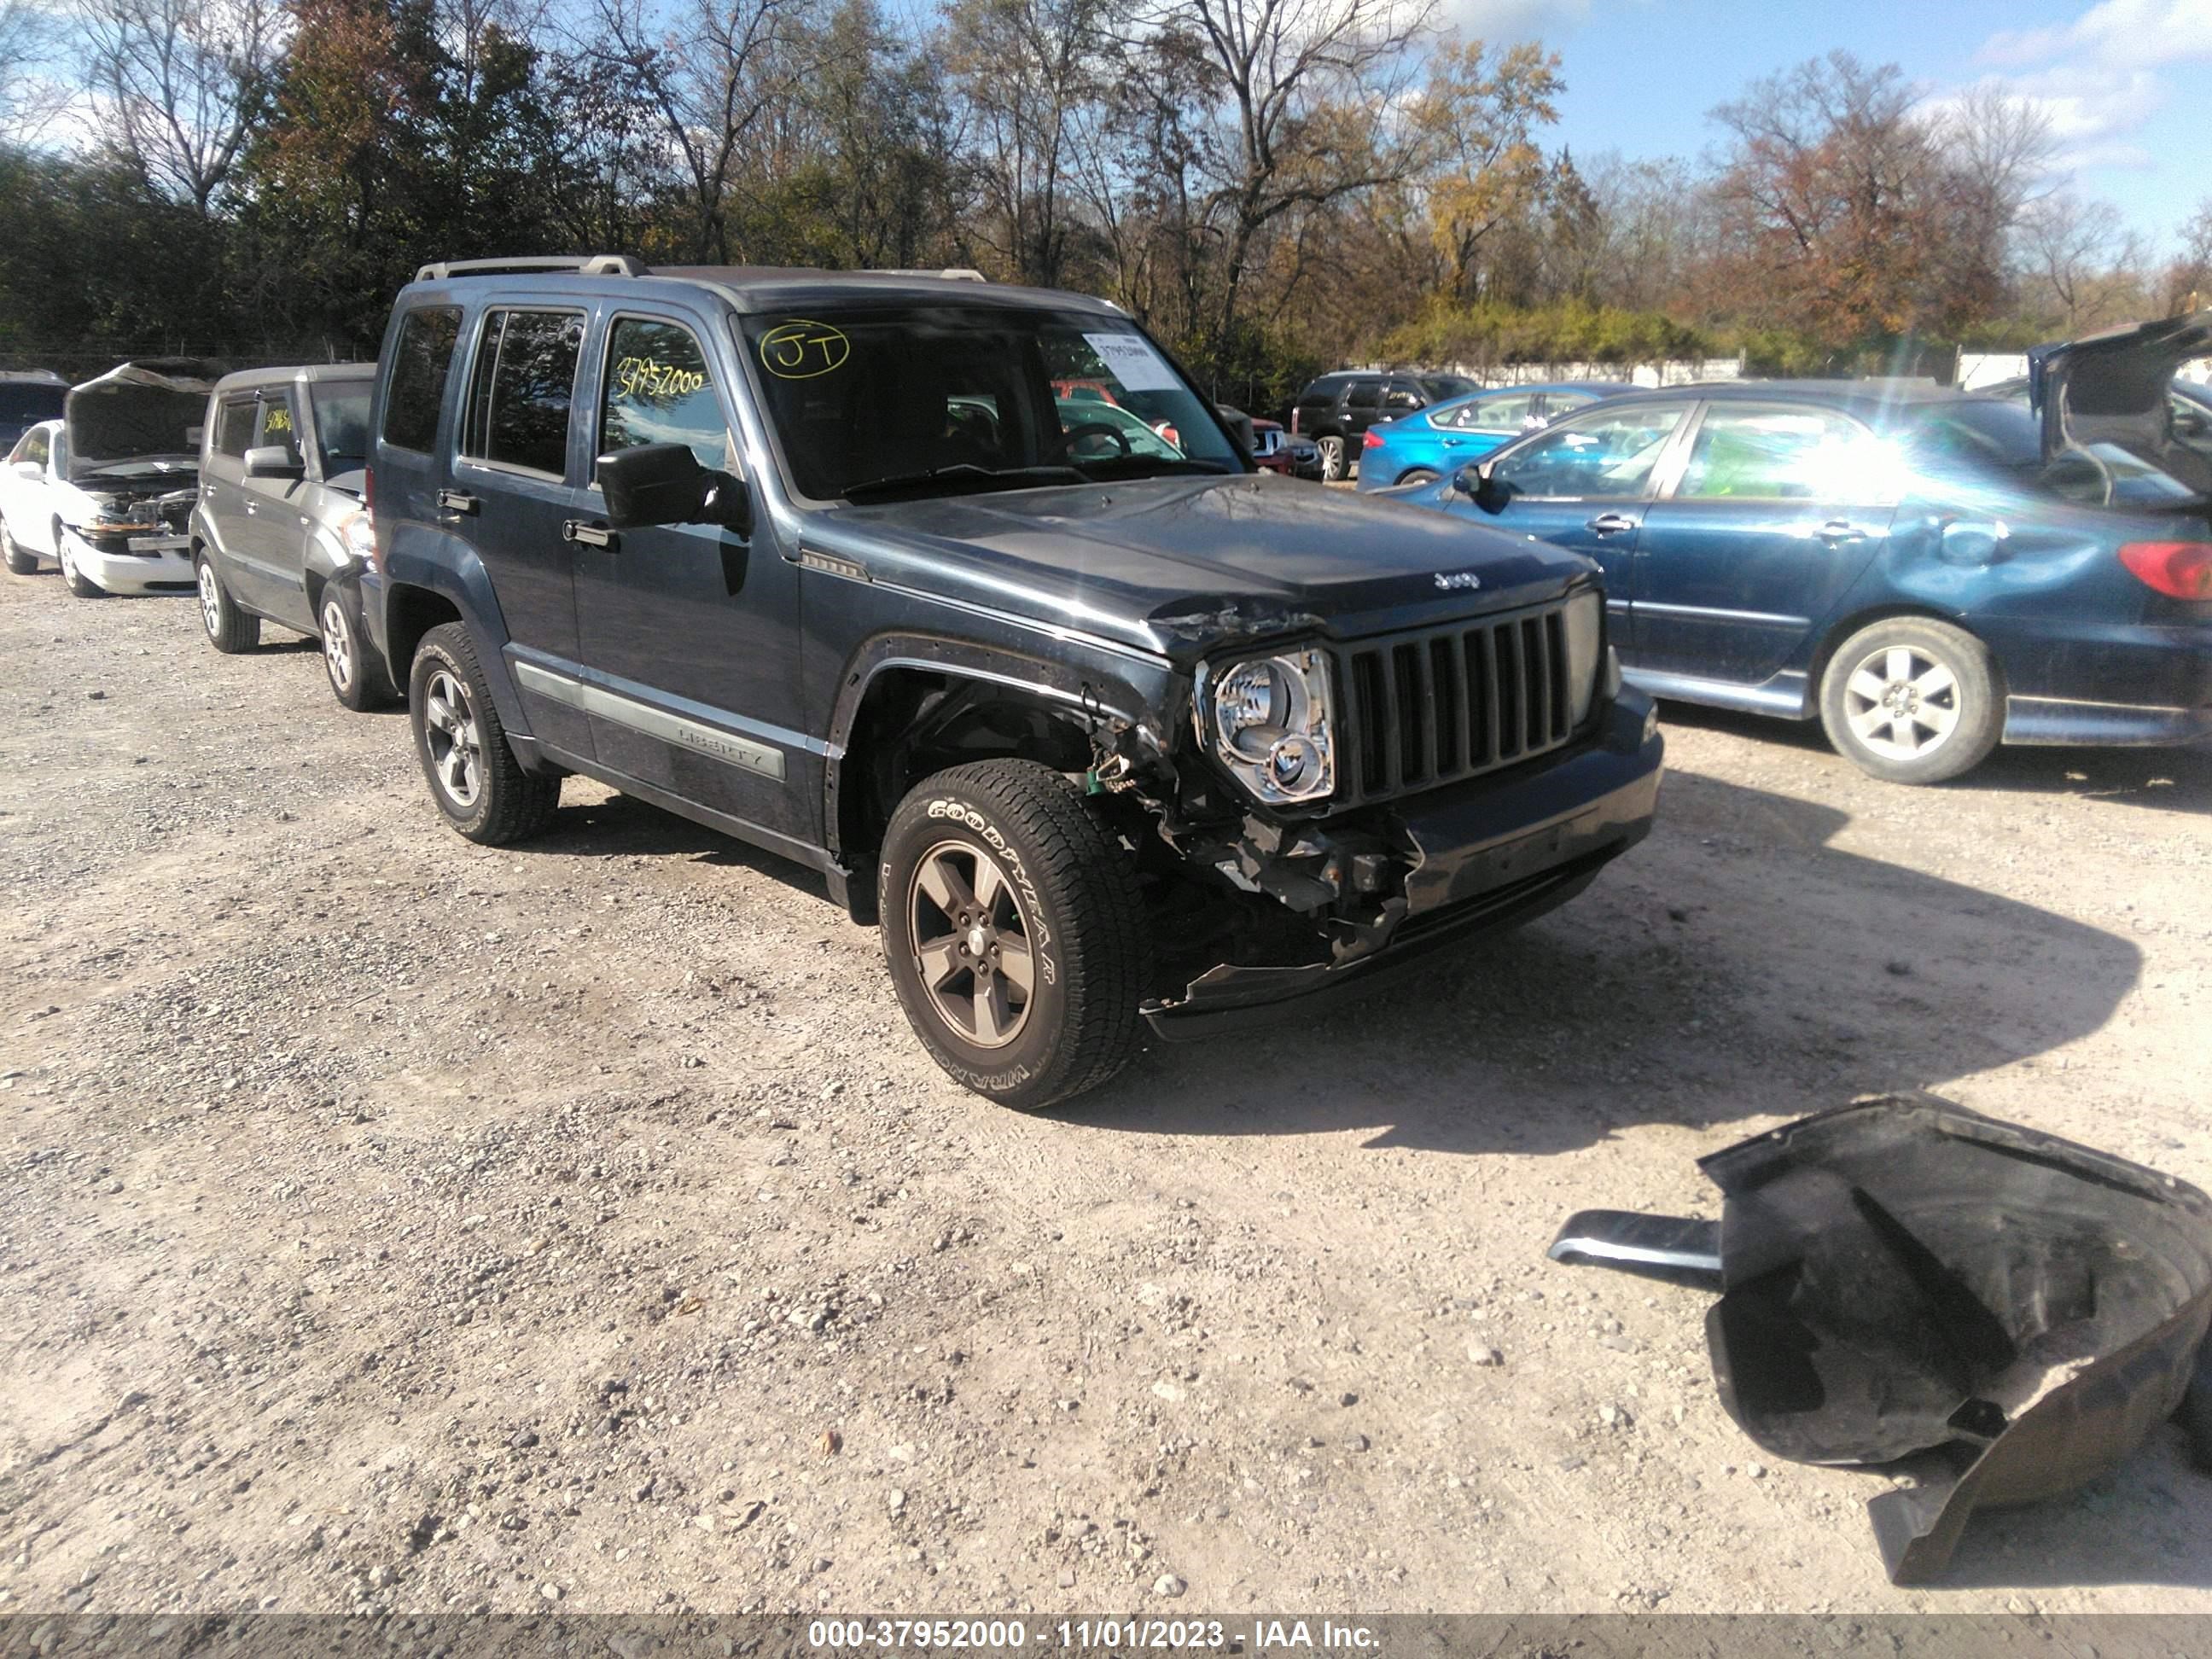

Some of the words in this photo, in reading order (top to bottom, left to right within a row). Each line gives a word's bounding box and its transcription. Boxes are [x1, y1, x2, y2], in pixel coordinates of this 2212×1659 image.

[771, 334, 846, 366] JT
[615, 357, 703, 399] 37952000
[677, 727, 763, 765] LIBERTY
[928, 800, 1057, 985] GOODYEAR
